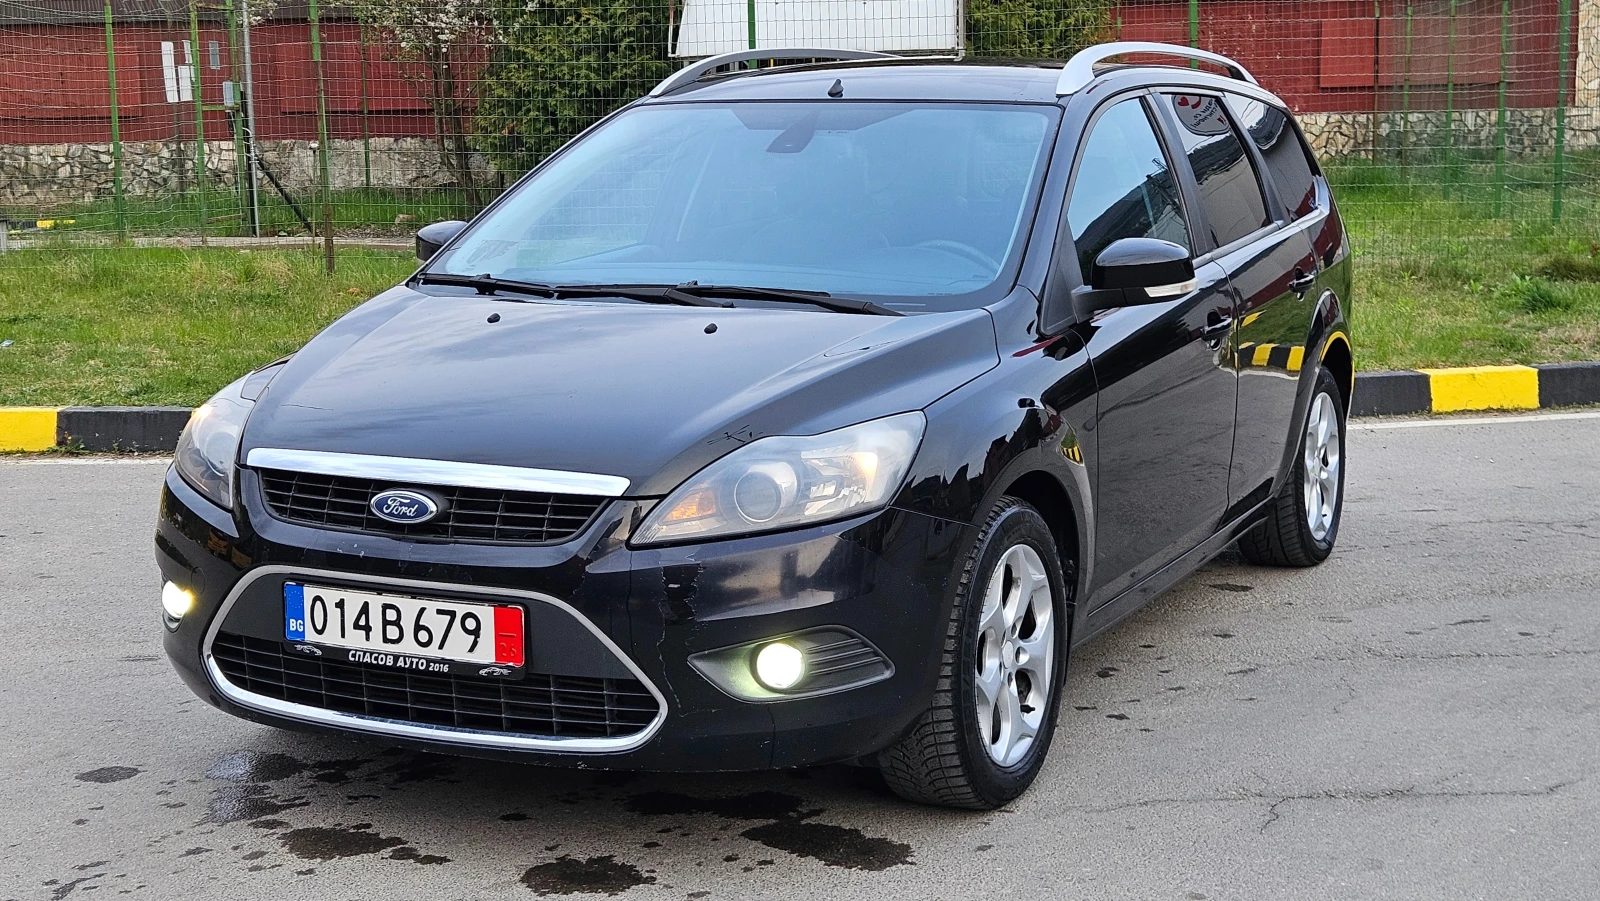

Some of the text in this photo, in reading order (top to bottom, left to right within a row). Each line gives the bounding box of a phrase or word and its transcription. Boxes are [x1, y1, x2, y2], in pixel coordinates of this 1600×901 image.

[383, 497, 418, 516] Ford
[289, 618, 304, 632] BG
[348, 650, 449, 673] СПАСОВ АУТО 2016
